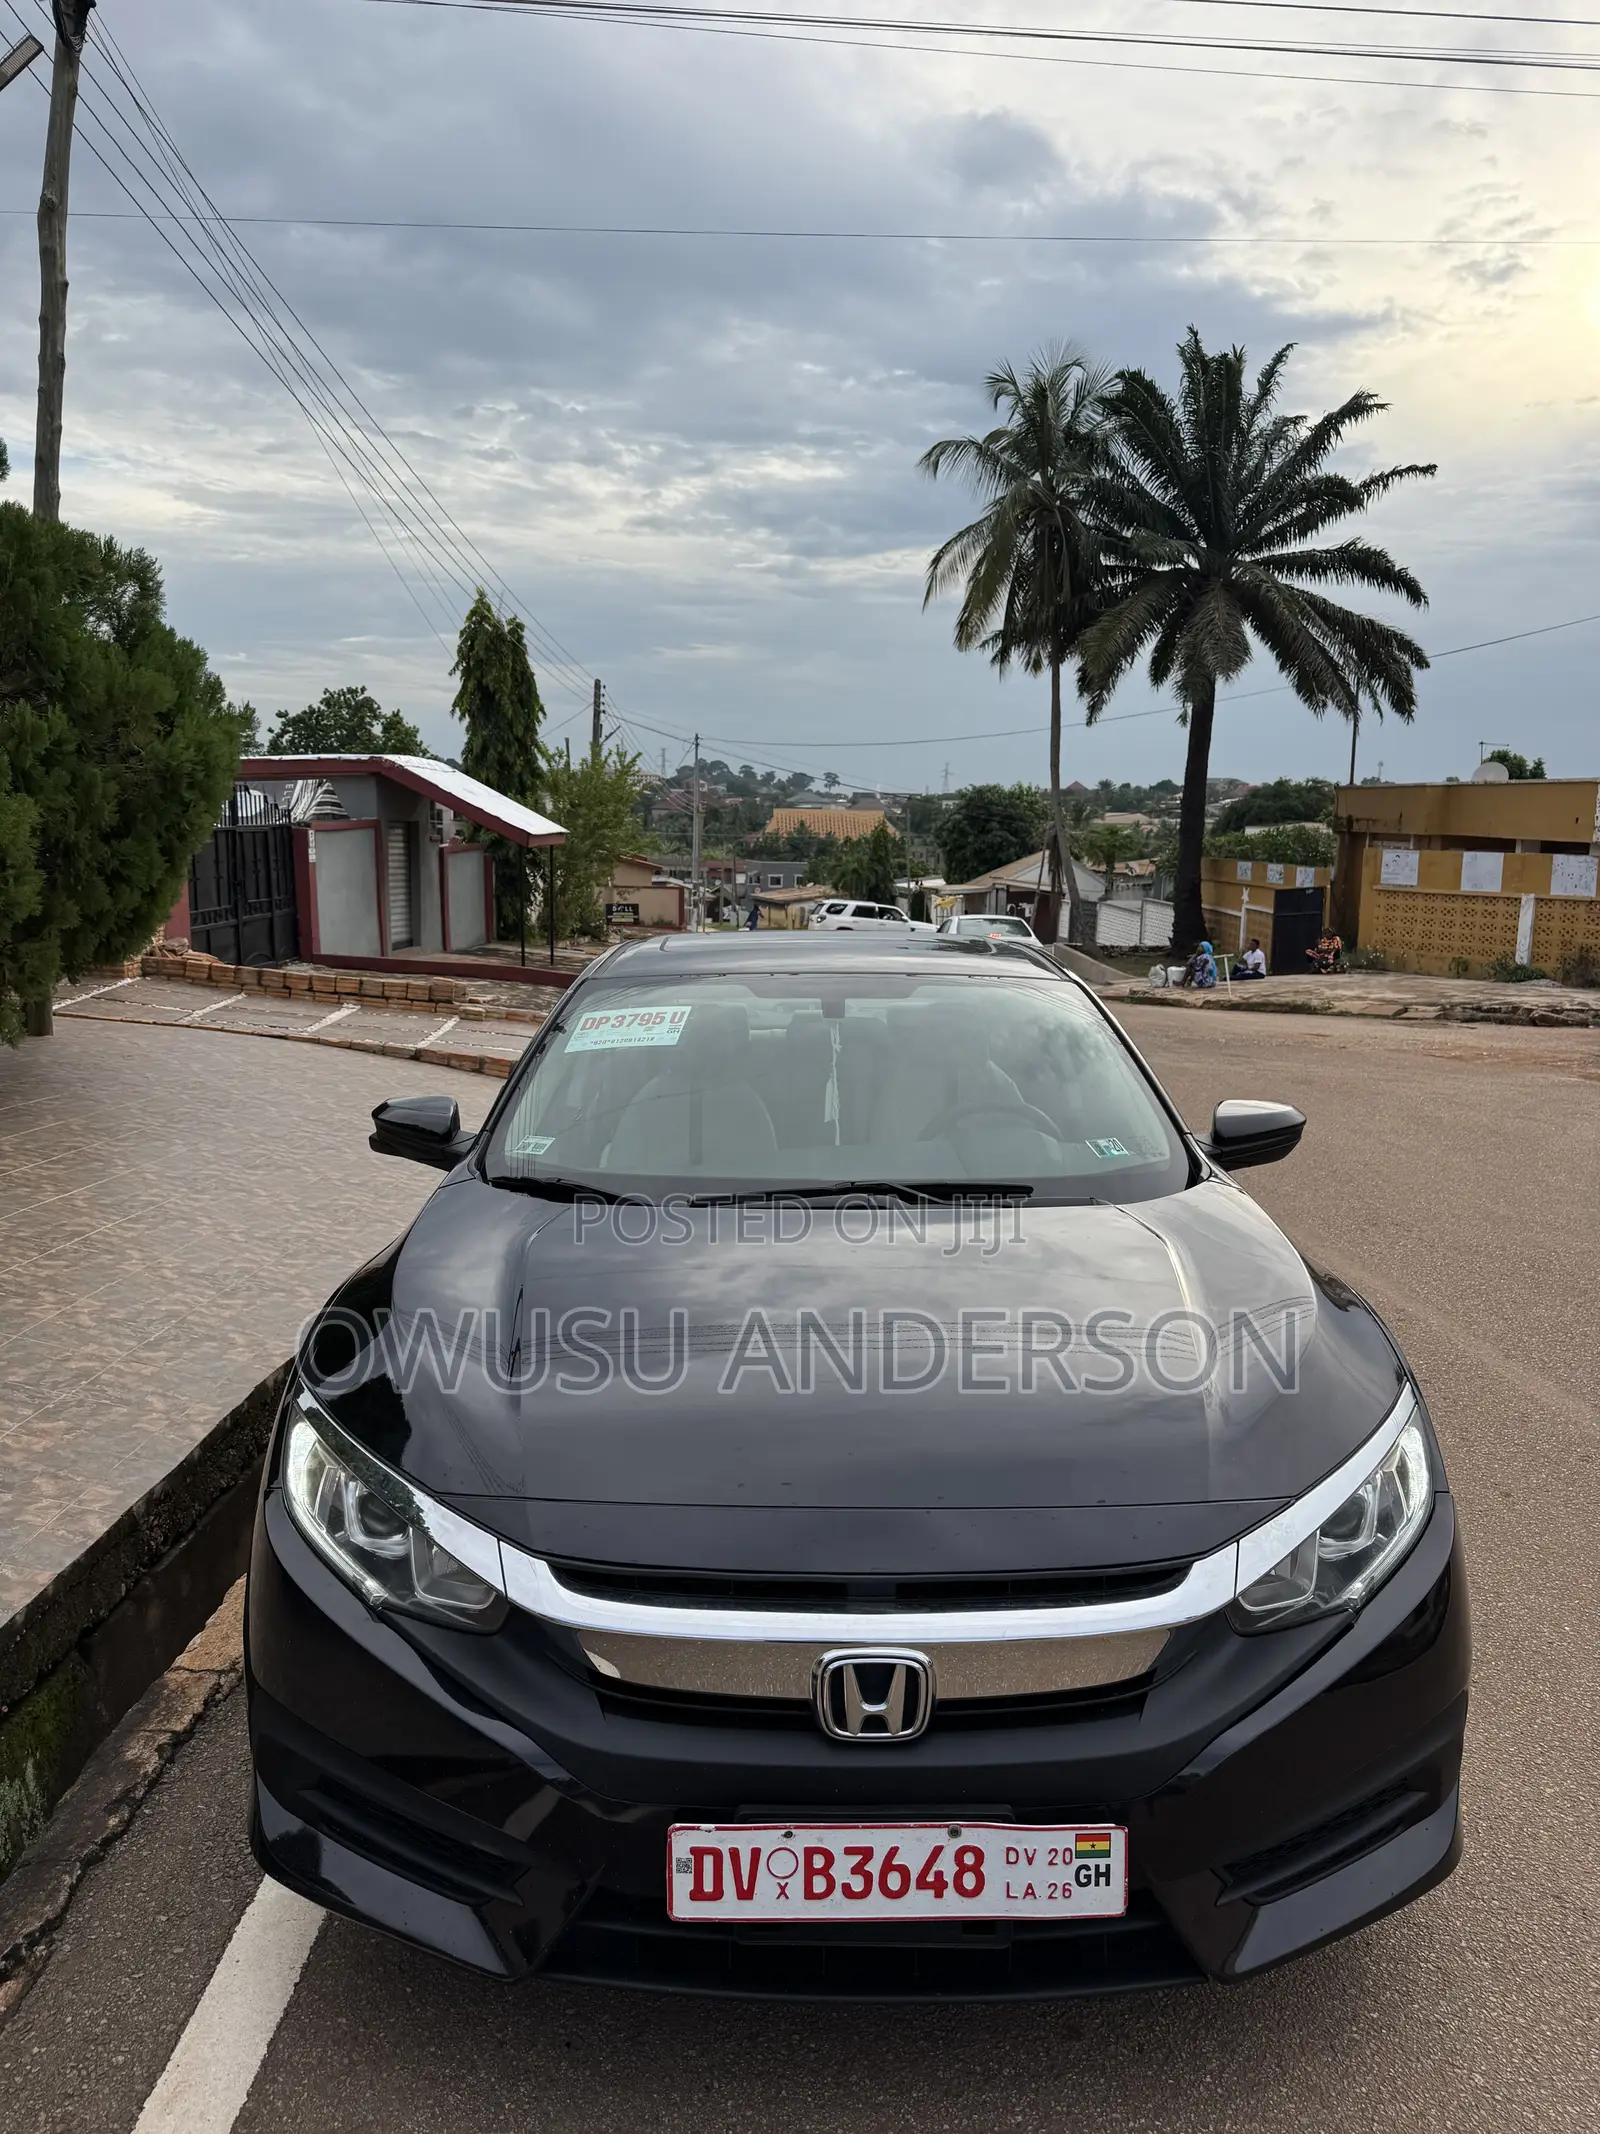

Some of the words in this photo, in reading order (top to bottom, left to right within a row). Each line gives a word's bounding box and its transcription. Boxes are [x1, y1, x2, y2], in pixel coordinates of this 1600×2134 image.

[1005, 1847, 1037, 1866] DV
[1048, 1847, 1073, 1865] 20
[689, 1846, 762, 1901] DV
[804, 1844, 986, 1900] B3648
[1074, 1864, 1111, 1888] GH
[1047, 1882, 1072, 1899] 26
